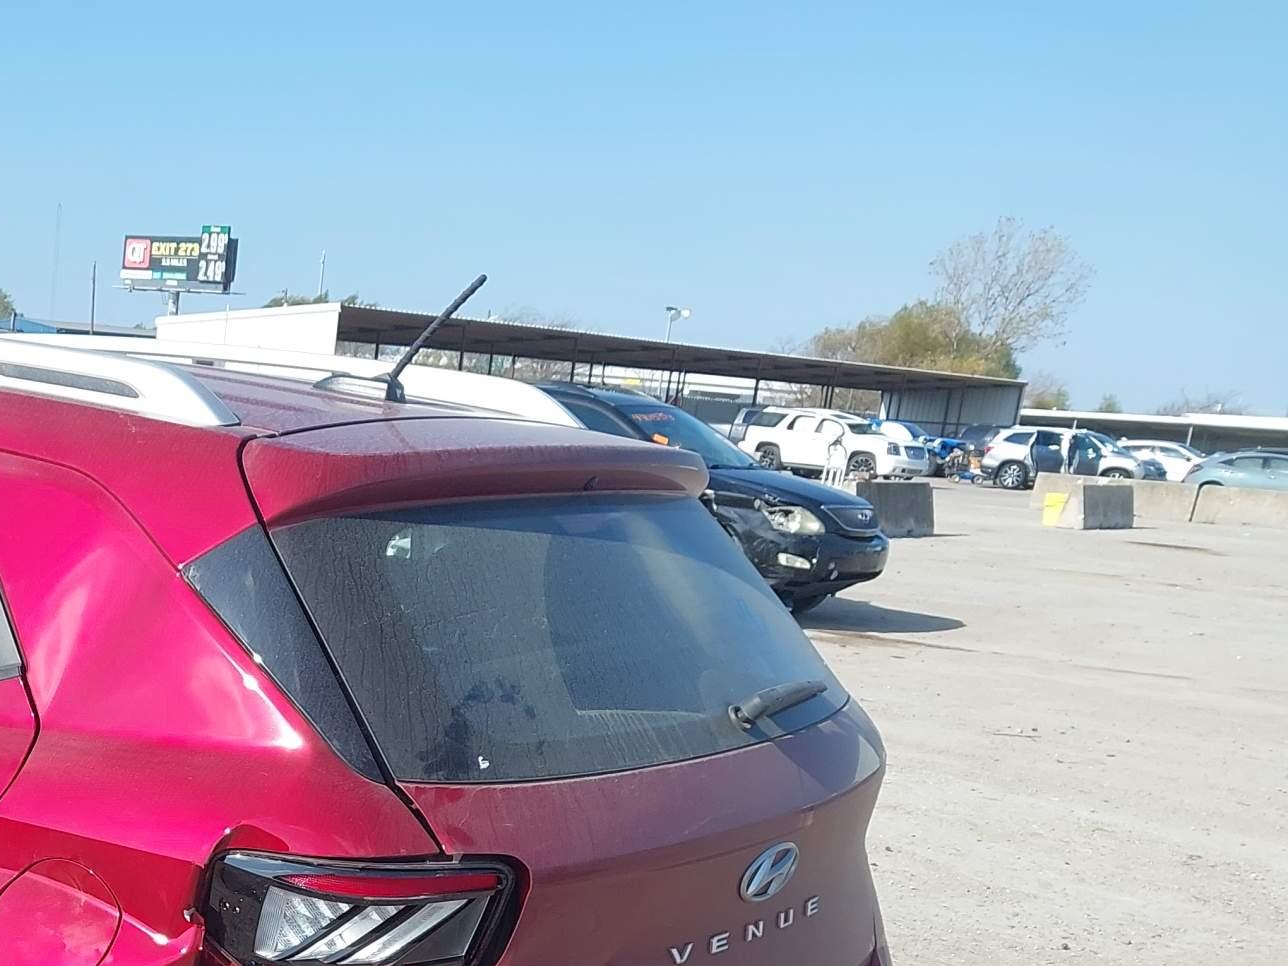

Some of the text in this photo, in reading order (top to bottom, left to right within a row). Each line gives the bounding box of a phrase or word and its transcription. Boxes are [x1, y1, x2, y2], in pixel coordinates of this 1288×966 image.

[128, 243, 148, 264] QT
[152, 242, 200, 256] EXIT 273
[669, 896, 820, 965] VENUE
